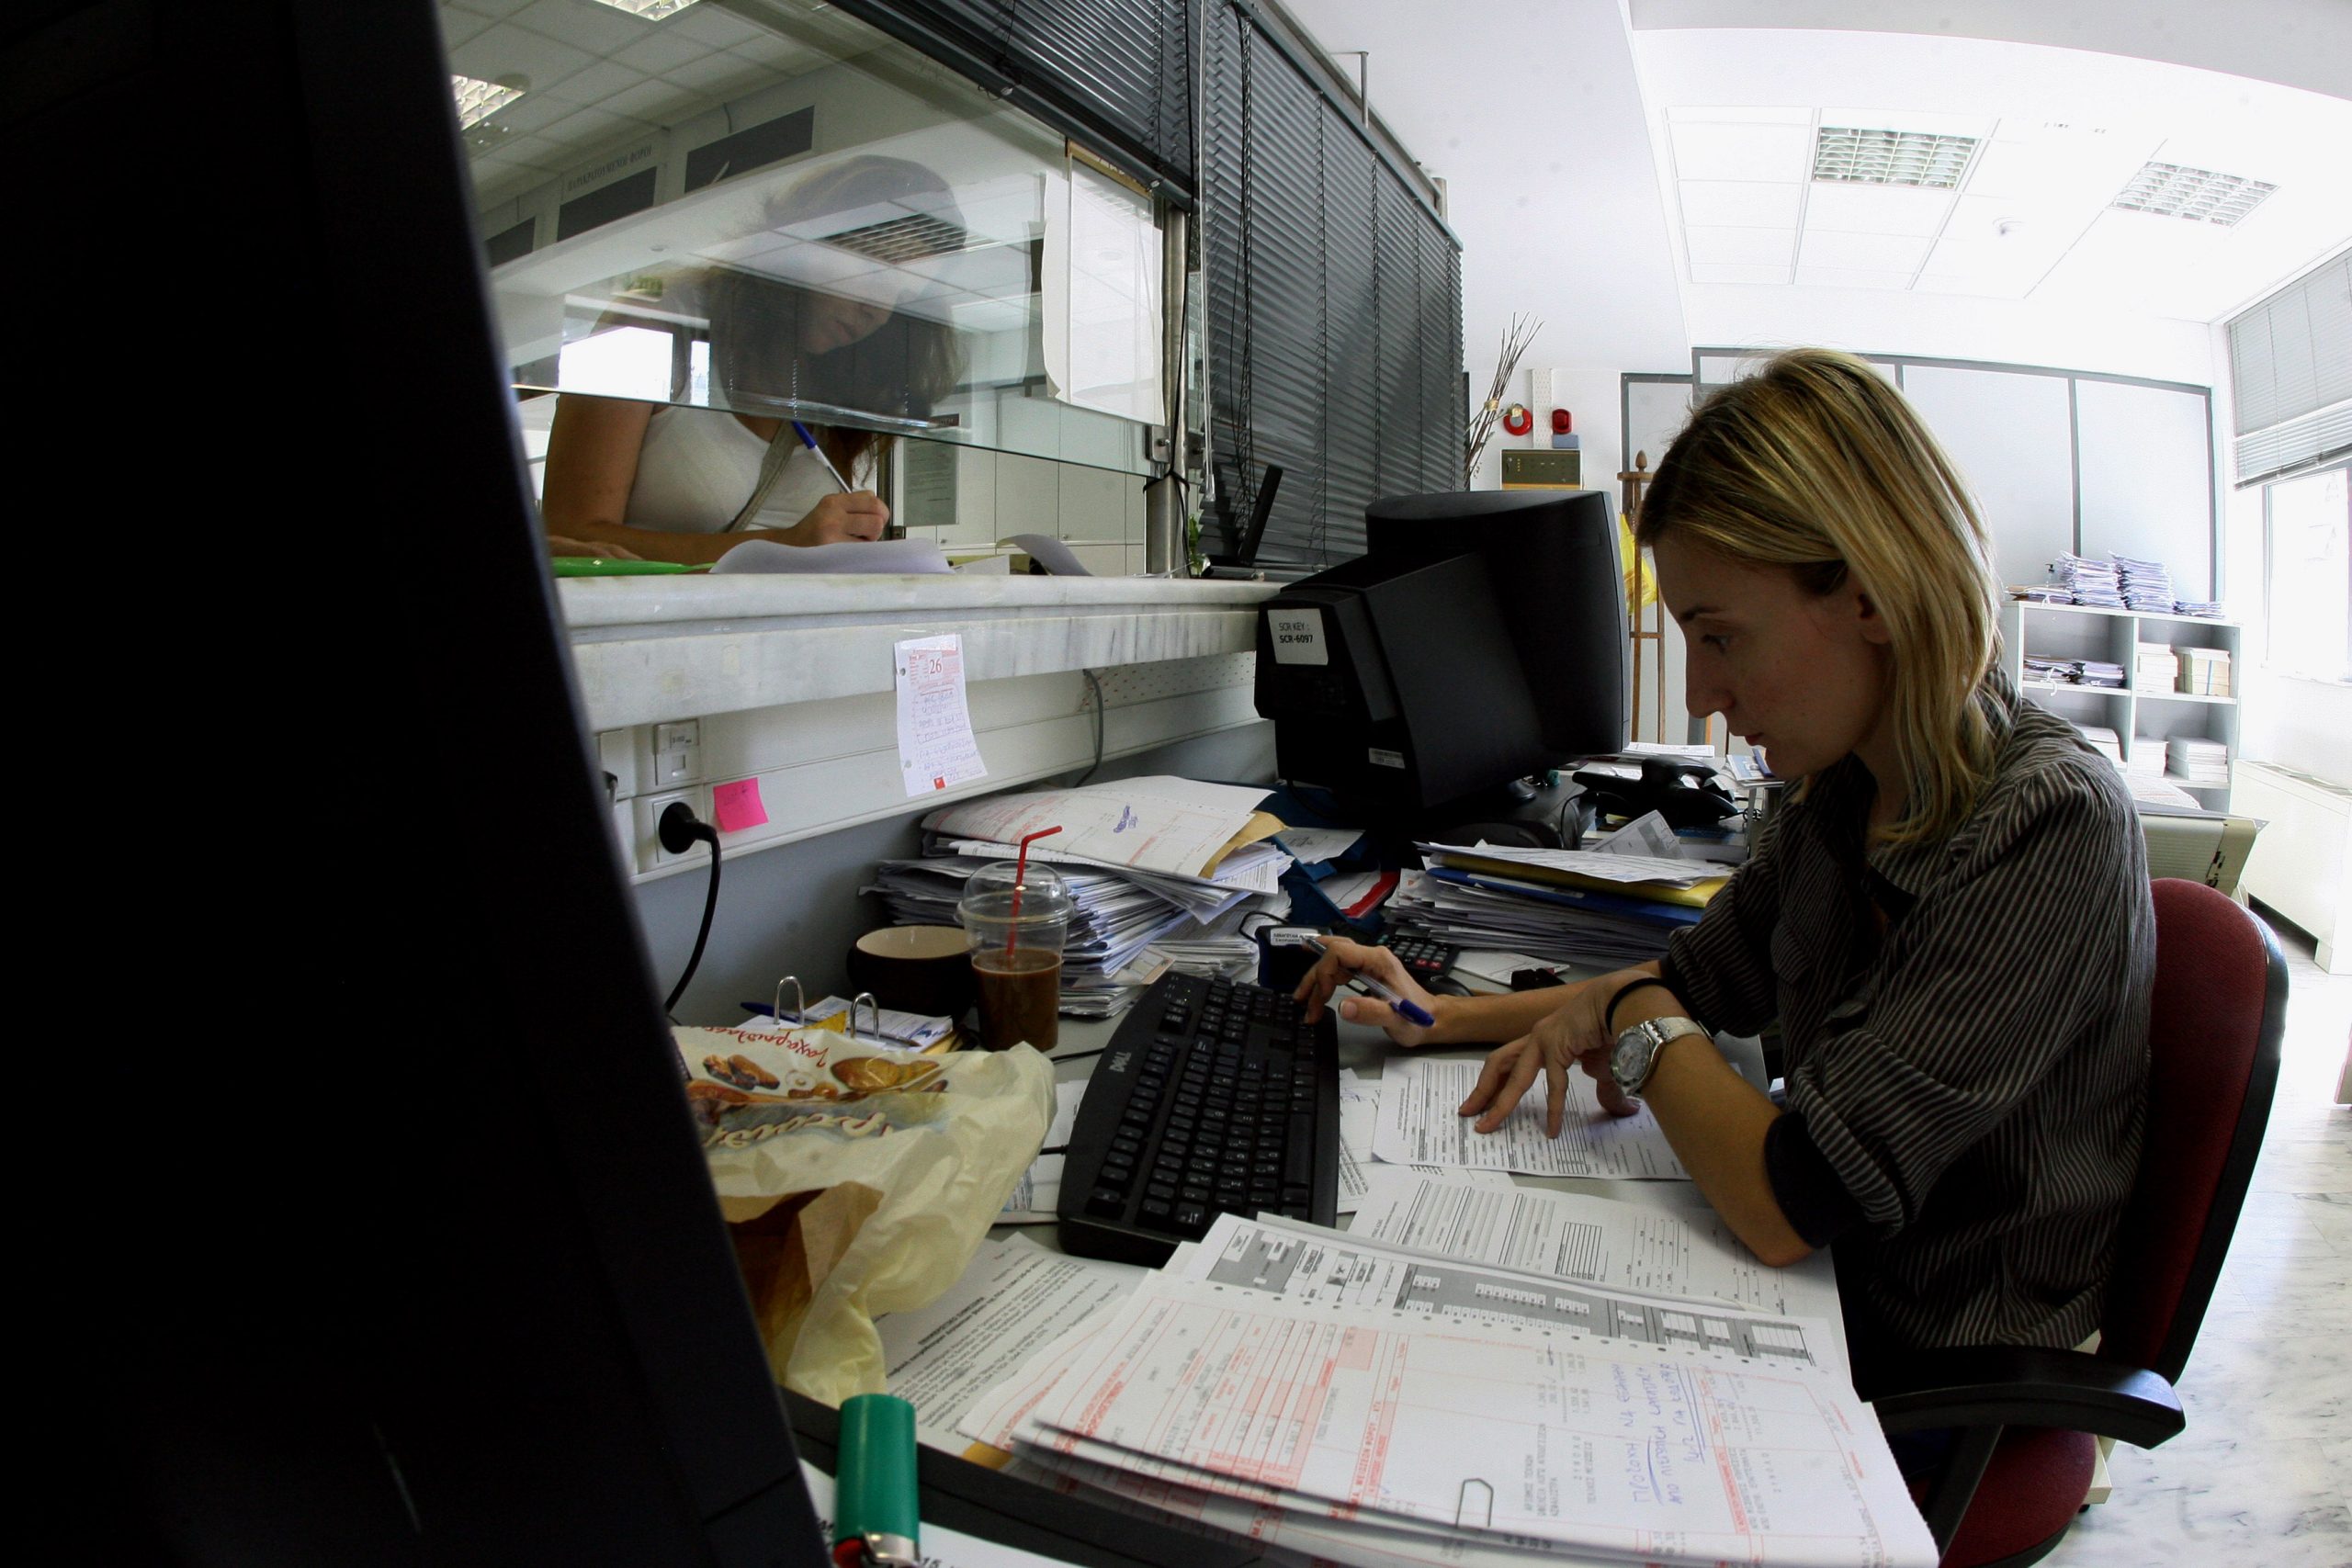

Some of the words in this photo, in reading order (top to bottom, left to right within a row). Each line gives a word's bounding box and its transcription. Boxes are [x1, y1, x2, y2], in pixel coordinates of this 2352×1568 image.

[1279, 622, 1292, 631] SCR
[1293, 622, 1305, 631] KEY
[1279, 635, 1313, 643] SCR-6097
[929, 659, 943, 674] 26
[1108, 1052, 1132, 1073] DELL
